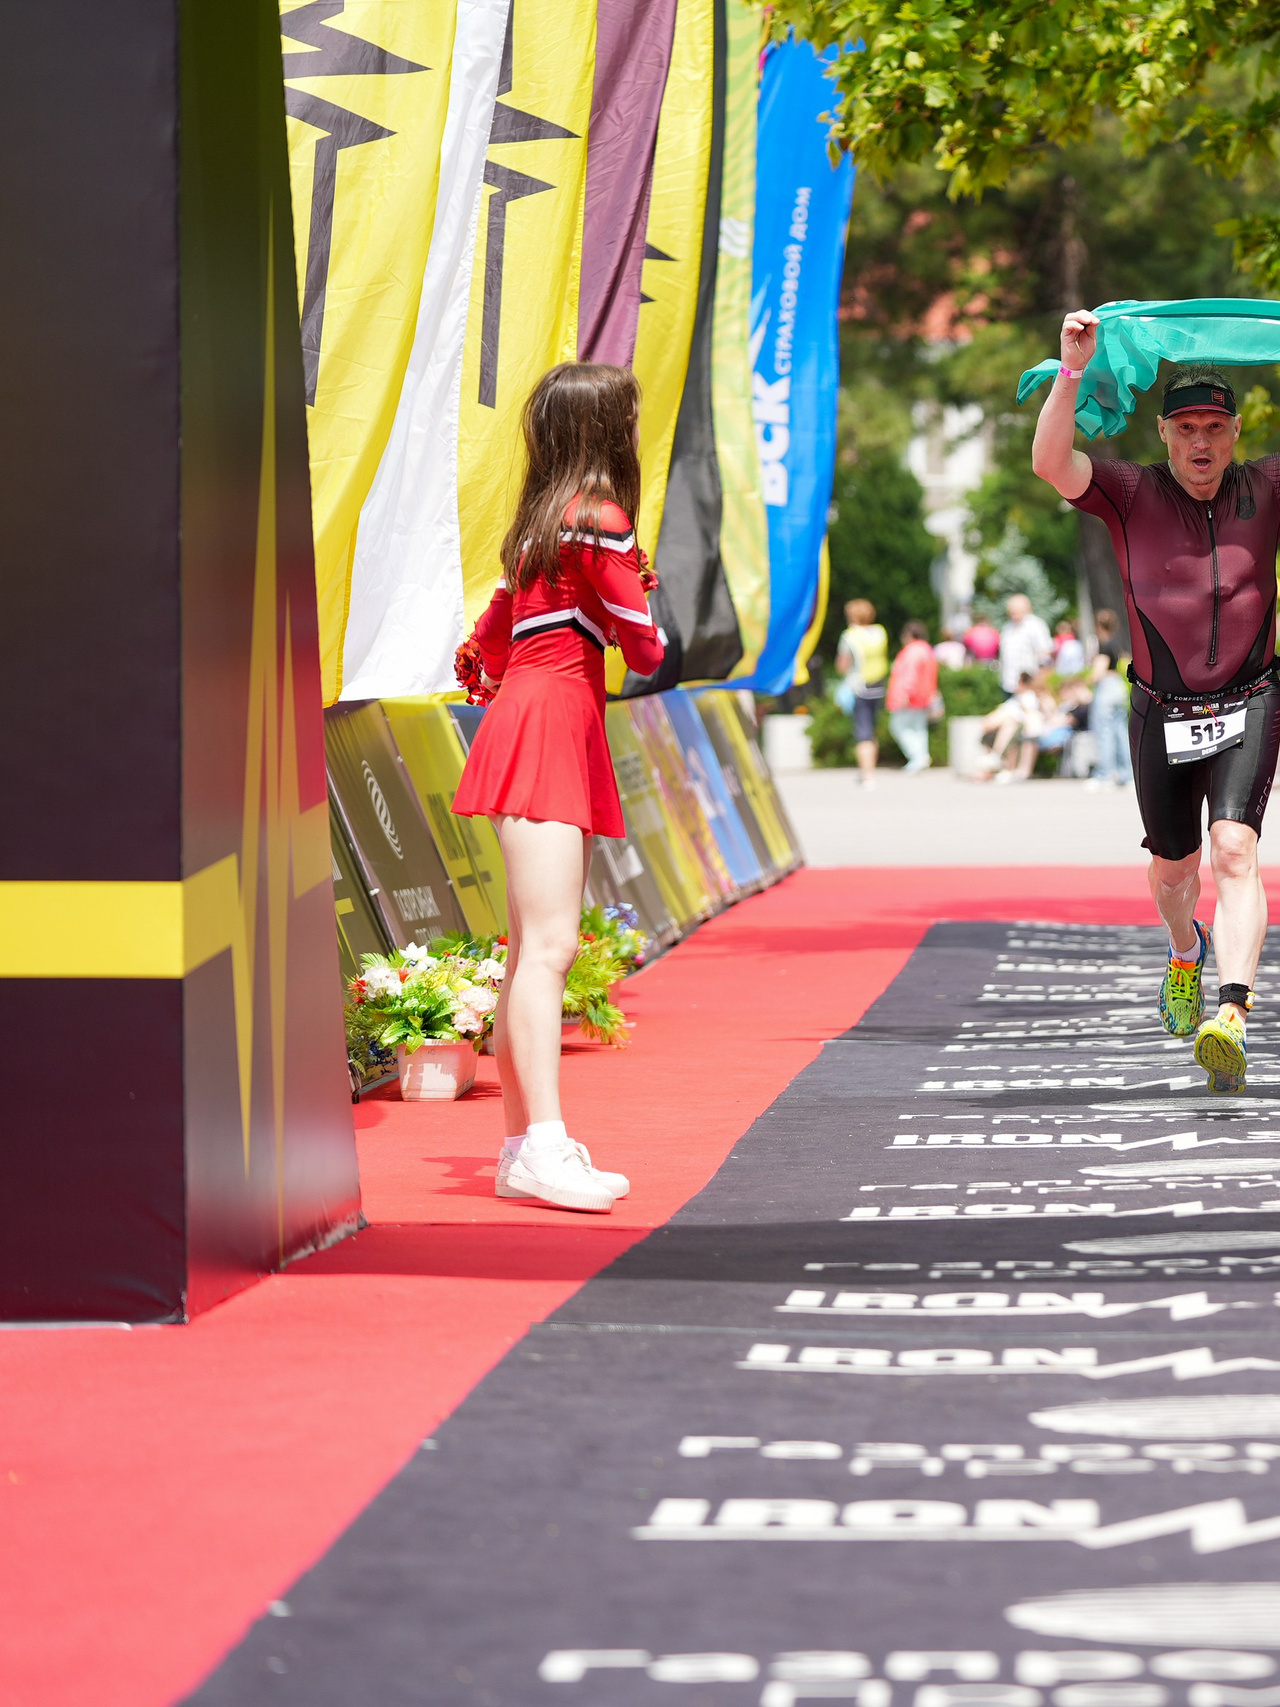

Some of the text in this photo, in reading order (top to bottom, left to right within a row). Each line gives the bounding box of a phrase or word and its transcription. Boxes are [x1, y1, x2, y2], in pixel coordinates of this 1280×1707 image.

[774, 186, 813, 376] СТРАХОВОЙ ДОМ
[752, 371, 791, 507] ВСК
[1190, 721, 1226, 746] 513
[922, 1076, 1125, 1089] IRON
[891, 1133, 1123, 1145] IRON
[849, 1203, 1117, 1218] IRON
[785, 1289, 1104, 1309] IRON
[746, 1342, 1098, 1368] IRON
[648, 1497, 1099, 1530] IRON
